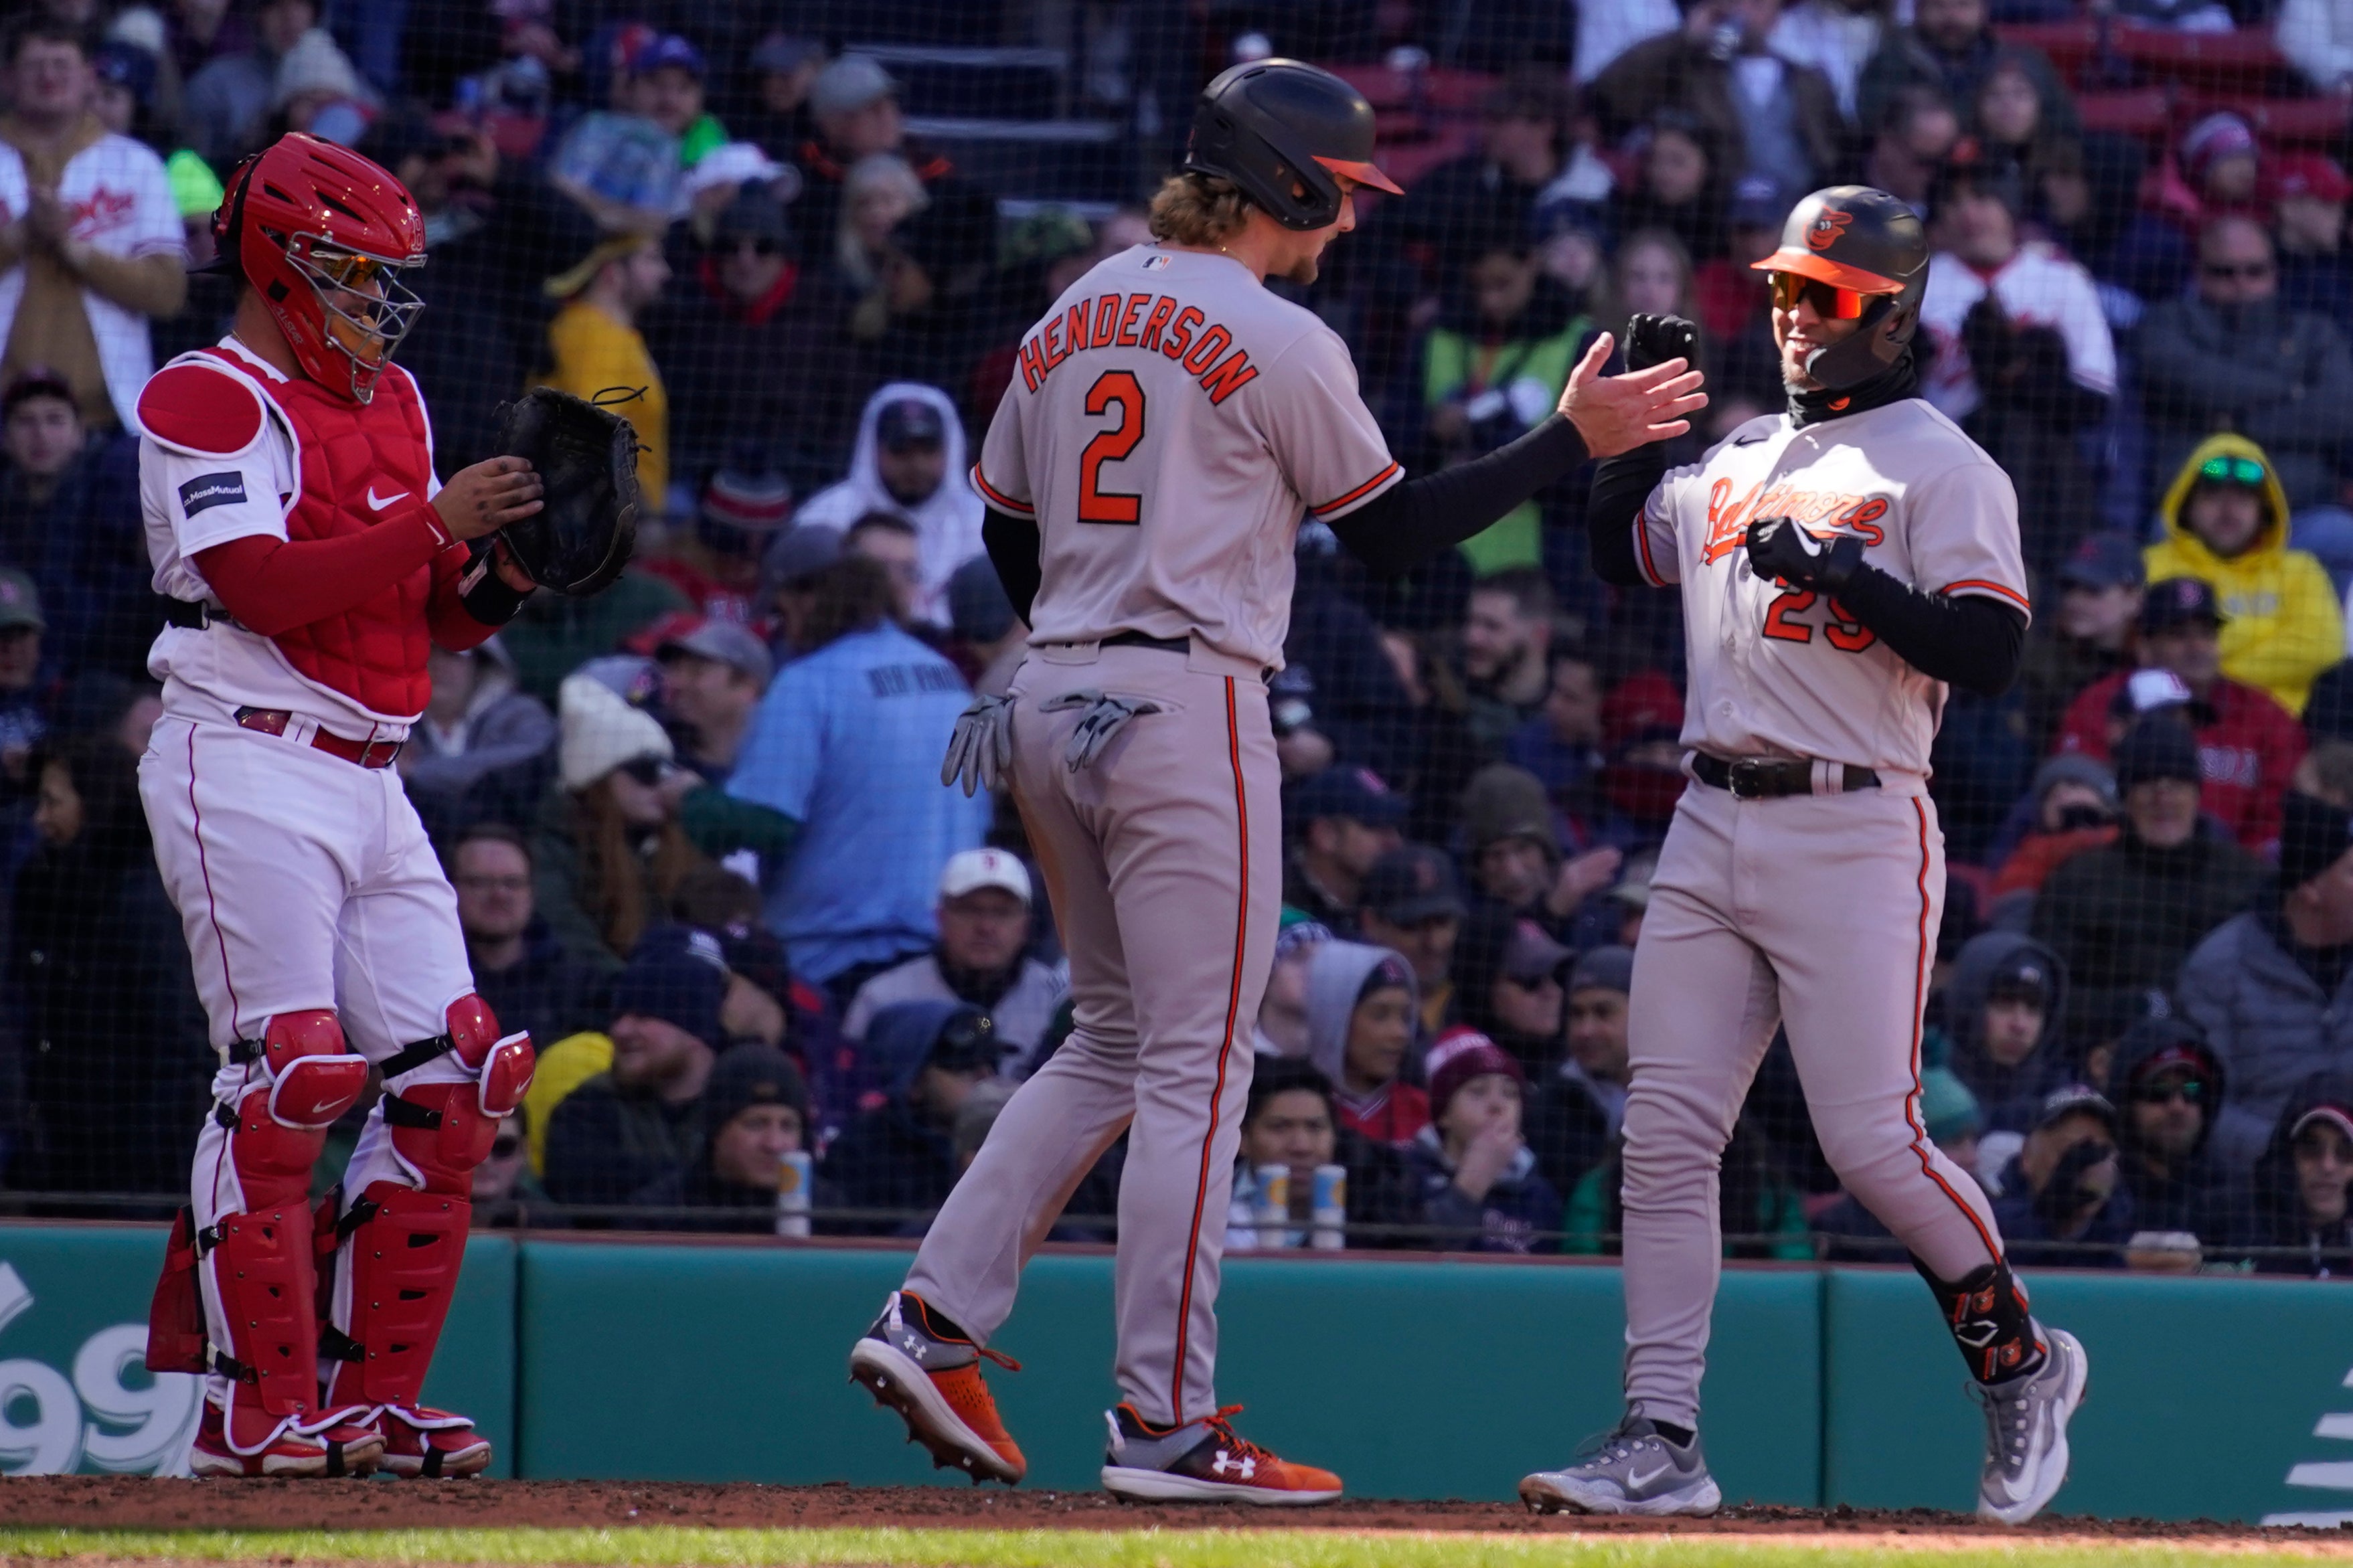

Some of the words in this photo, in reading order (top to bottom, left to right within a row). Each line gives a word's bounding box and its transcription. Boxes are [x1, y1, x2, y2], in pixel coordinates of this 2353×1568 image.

[1018, 293, 1259, 406] HENDERSON
[189, 485, 243, 503] MassMutual
[1077, 369, 1145, 525] 2
[1699, 476, 1888, 565] Baltimore
